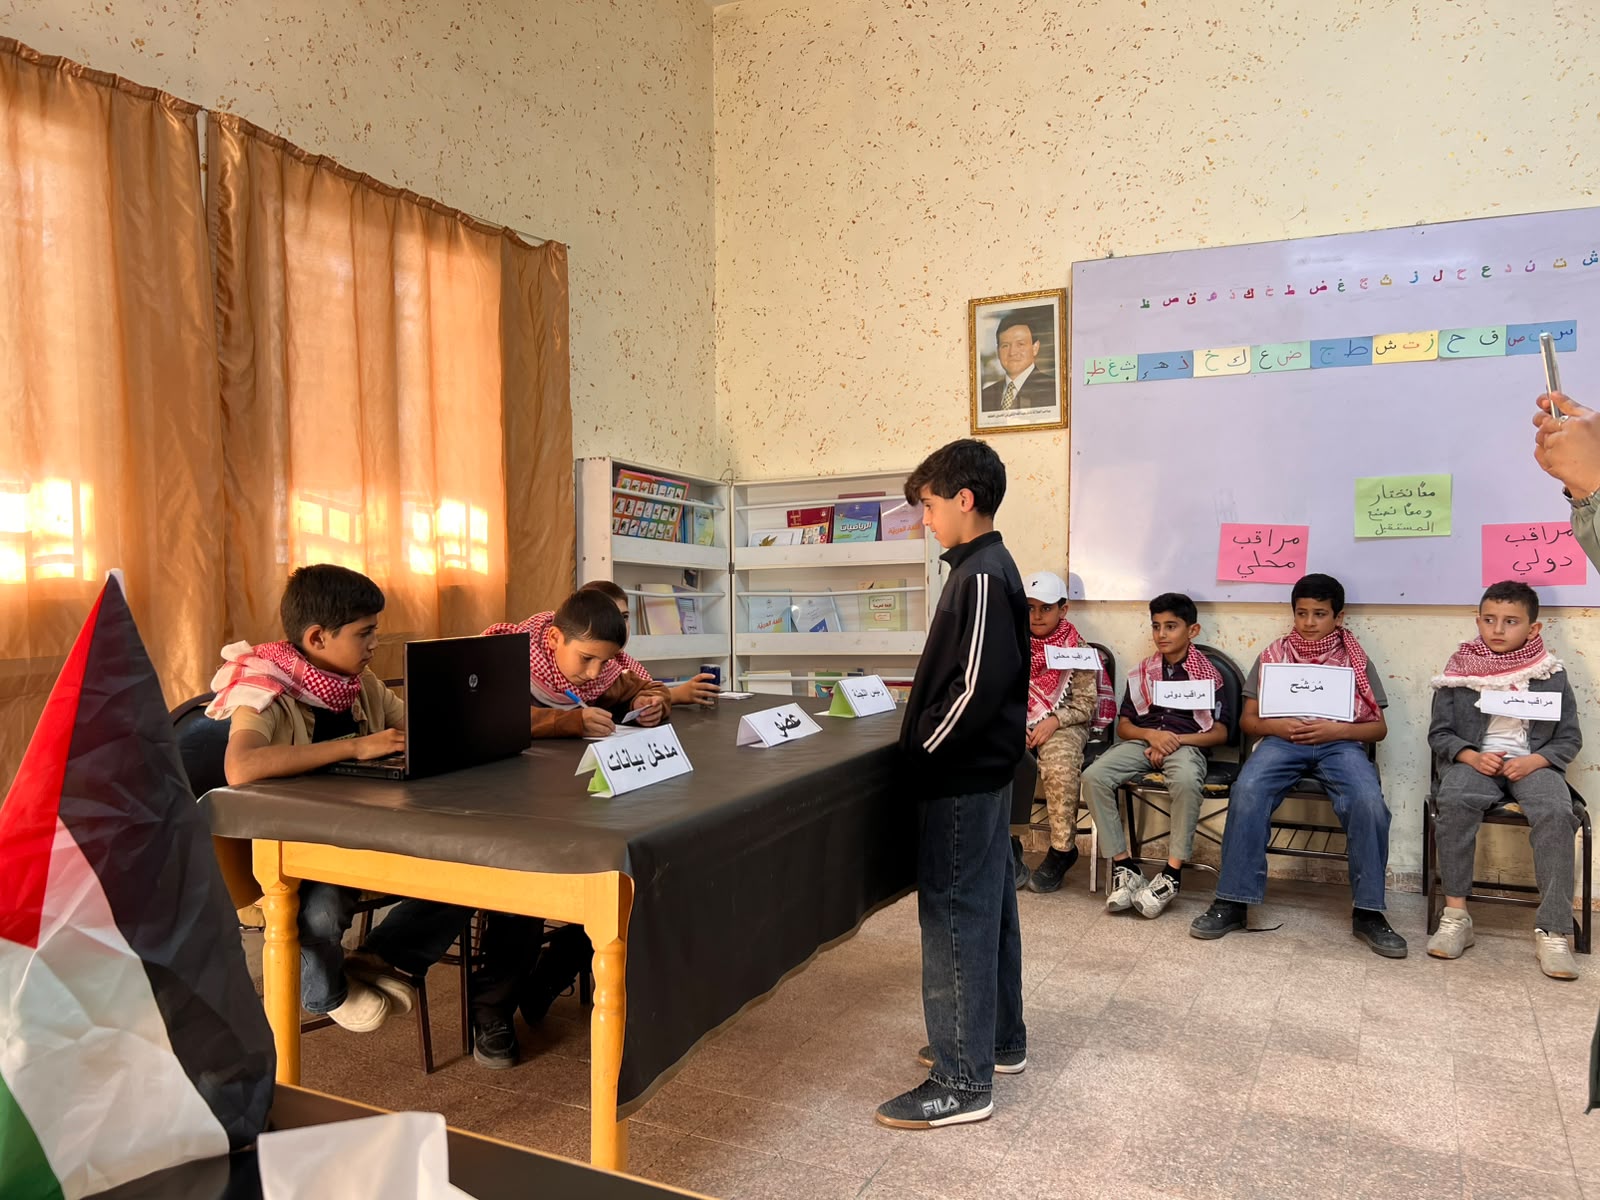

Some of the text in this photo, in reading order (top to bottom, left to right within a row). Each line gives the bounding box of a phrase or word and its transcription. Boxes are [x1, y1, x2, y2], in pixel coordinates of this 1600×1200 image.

[1525, 260, 1535, 272] ن
[1553, 258, 1567, 268] ت
[1582, 250, 1599, 266] ش
[1409, 271, 1419, 284] ز
[1433, 269, 1443, 282] ل
[1481, 265, 1492, 278] ع
[1243, 288, 1254, 299] ك
[1309, 280, 1328, 295] ض
[1162, 297, 1179, 306] ص
[1187, 292, 1197, 305] ق
[1402, 341, 1420, 350] ت
[1424, 334, 1435, 352] ز
[1446, 333, 1466, 353] ح
[1479, 330, 1499, 346] ق
[1507, 335, 1526, 347] ص
[1319, 346, 1335, 365] ج
[1344, 339, 1369, 358] ط
[1375, 340, 1397, 355] ش
[1177, 355, 1190, 370] ذ
[1204, 349, 1219, 371] خ
[1227, 348, 1247, 367] ك
[1258, 349, 1273, 370] ع
[1277, 350, 1302, 367] ض
[1368, 484, 1413, 507] نختار
[840, 521, 873, 533] الرياضيات
[1375, 521, 1434, 536] المستقبل
[1232, 528, 1300, 555] مراقب
[1504, 525, 1574, 548] مراقب
[1236, 550, 1296, 579] محلي
[1512, 548, 1573, 576] دولي
[774, 712, 801, 738] عضو
[607, 742, 678, 772] مدخل بيانات
[921, 1094, 961, 1118] FILA
